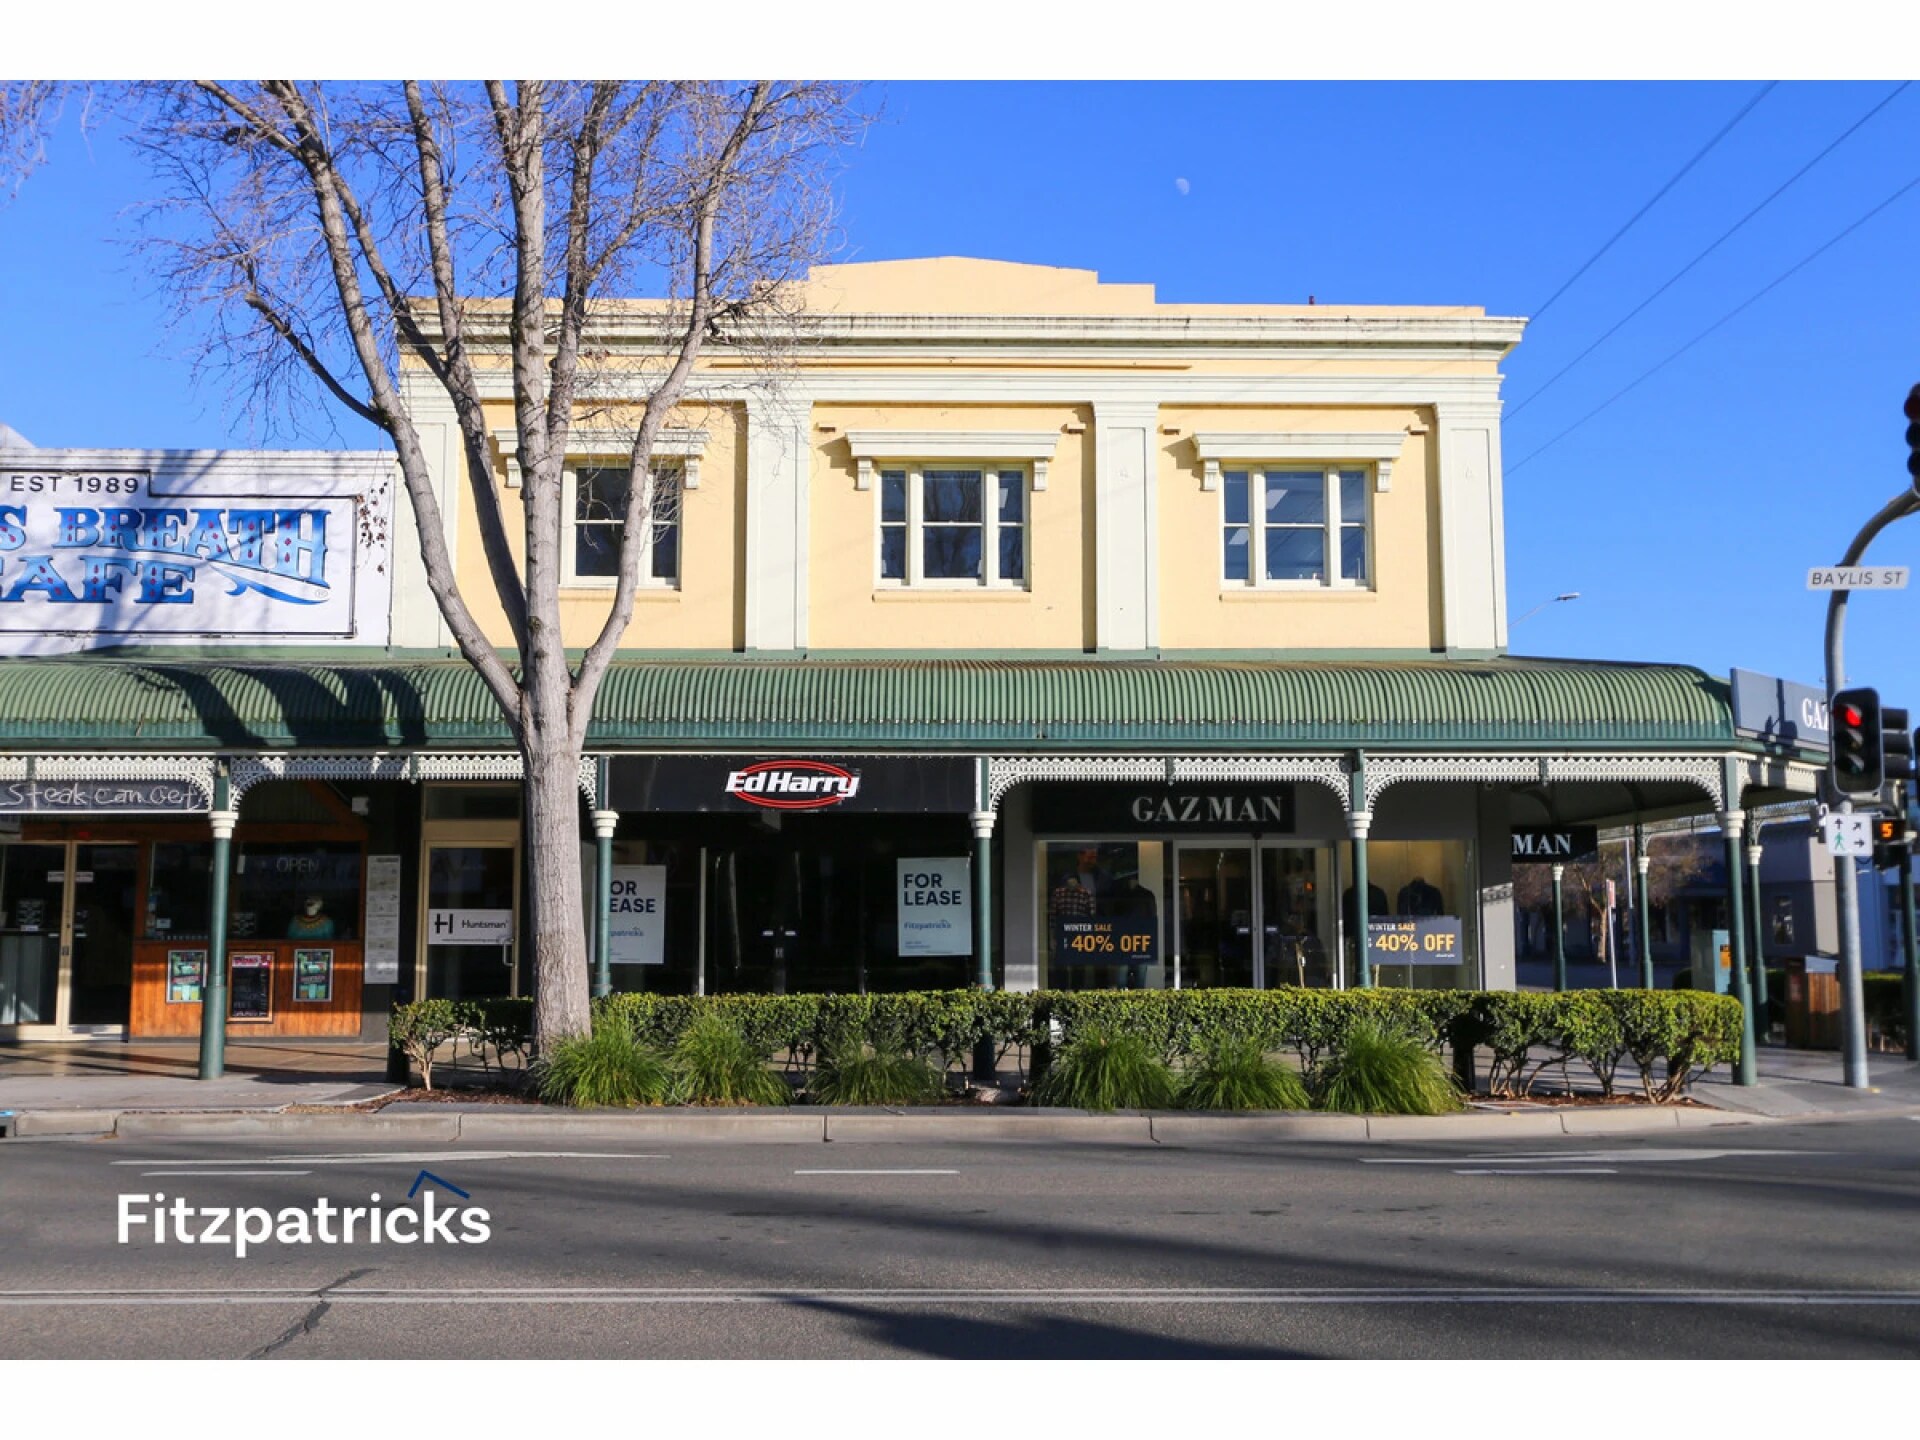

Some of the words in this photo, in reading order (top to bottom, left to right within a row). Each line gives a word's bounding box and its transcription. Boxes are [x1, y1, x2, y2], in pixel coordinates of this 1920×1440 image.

[10, 476, 61, 492] EST
[75, 476, 139, 494] 1989
[53, 507, 330, 588] BREATH
[0, 555, 196, 604] AFE
[1811, 571, 1873, 585] BAYLIS
[1882, 571, 1904, 585] ST
[2, 783, 87, 812] Steak
[1879, 821, 1894, 839] 5
[276, 856, 321, 873] OPEN
[610, 880, 638, 896] OR
[903, 873, 943, 889] FOR
[610, 898, 657, 913] EASE
[903, 890, 962, 906] LEASE
[462, 919, 507, 929] Huntsman
[1063, 923, 1092, 932] WINTER
[1094, 923, 1113, 932] SALE
[1398, 922, 1416, 931] SALE
[1071, 935, 1115, 953] 40%
[1120, 935, 1152, 953] OFF
[1375, 933, 1419, 952] 40%
[1423, 933, 1455, 952] OFF
